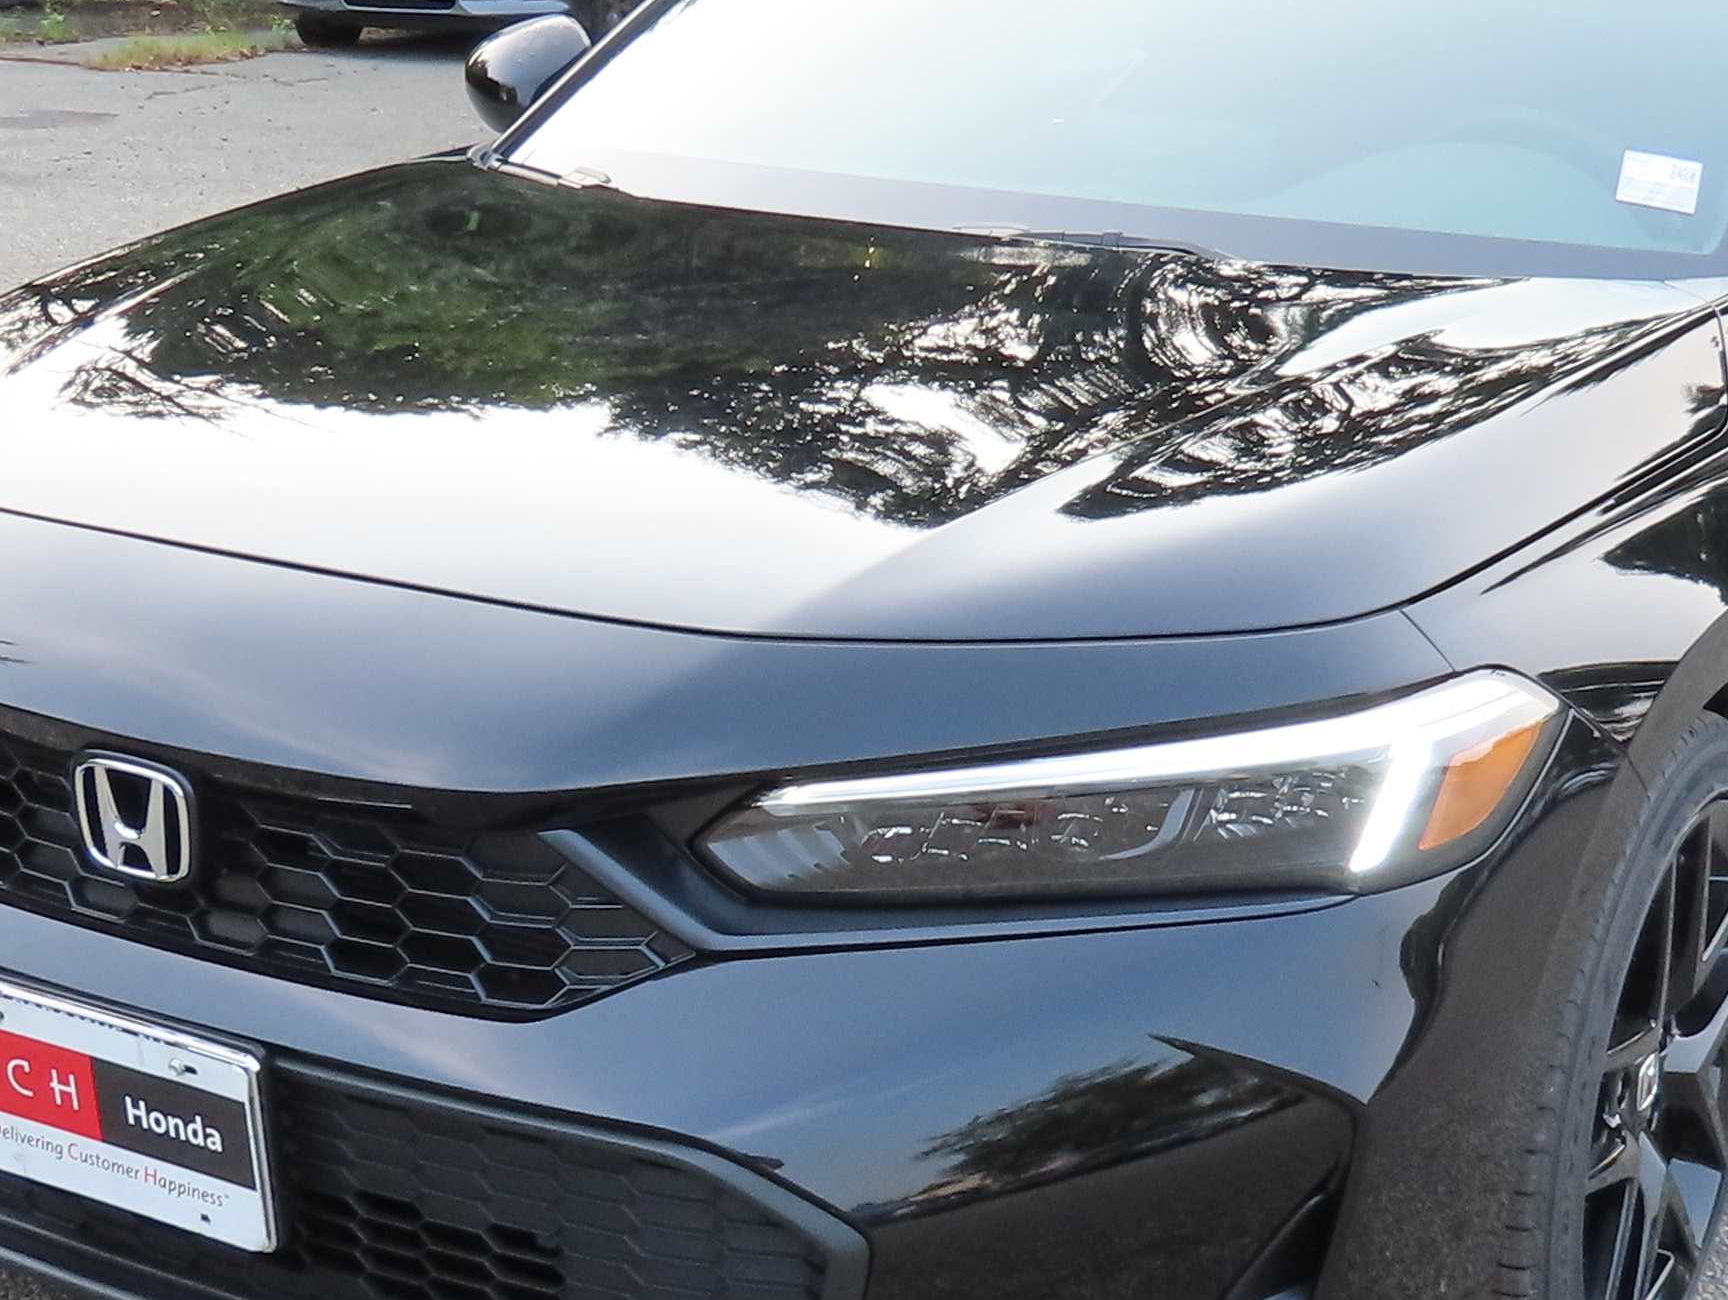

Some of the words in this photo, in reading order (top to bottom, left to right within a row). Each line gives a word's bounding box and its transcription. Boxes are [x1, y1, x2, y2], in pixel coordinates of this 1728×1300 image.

[83, 759, 180, 881] H
[124, 1095, 223, 1153] Honda
[67, 1142, 140, 1180] Customer
[143, 1165, 224, 1207] Happiness
